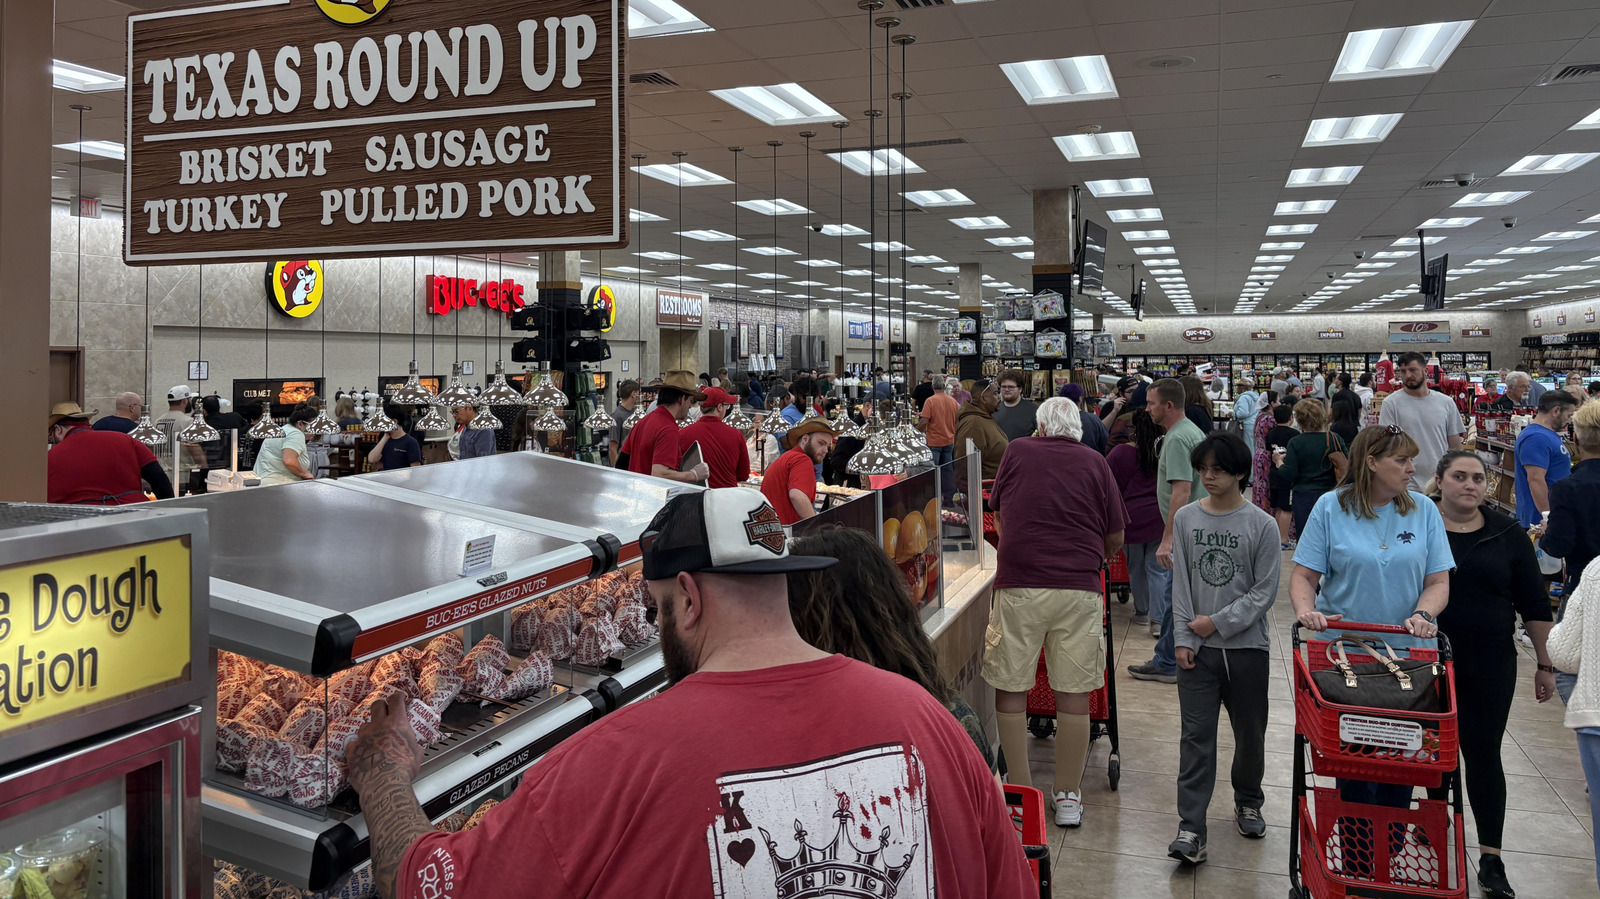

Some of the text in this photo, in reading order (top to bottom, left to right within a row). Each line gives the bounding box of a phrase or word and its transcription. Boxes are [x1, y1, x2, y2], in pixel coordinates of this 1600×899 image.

[143, 14, 598, 124] TEXAS ROUND UP
[179, 123, 551, 185] BRISKET SAUSAGE
[80, 198, 98, 217] EXIT
[143, 174, 596, 235] TURKEY PULLED PORK
[659, 294, 702, 317] RESTROOMS
[243, 389, 257, 398] CLUB
[1192, 528, 1240, 549] Levi's
[32, 555, 163, 633] Dough
[478, 586, 521, 610] GLAZED
[520, 576, 548, 596] NUTS
[412, 701, 434, 723] PECANS
[413, 720, 436, 741] PECANS
[449, 772, 492, 805] GLAZED
[493, 749, 530, 779] PECANS
[720, 790, 753, 834] K
